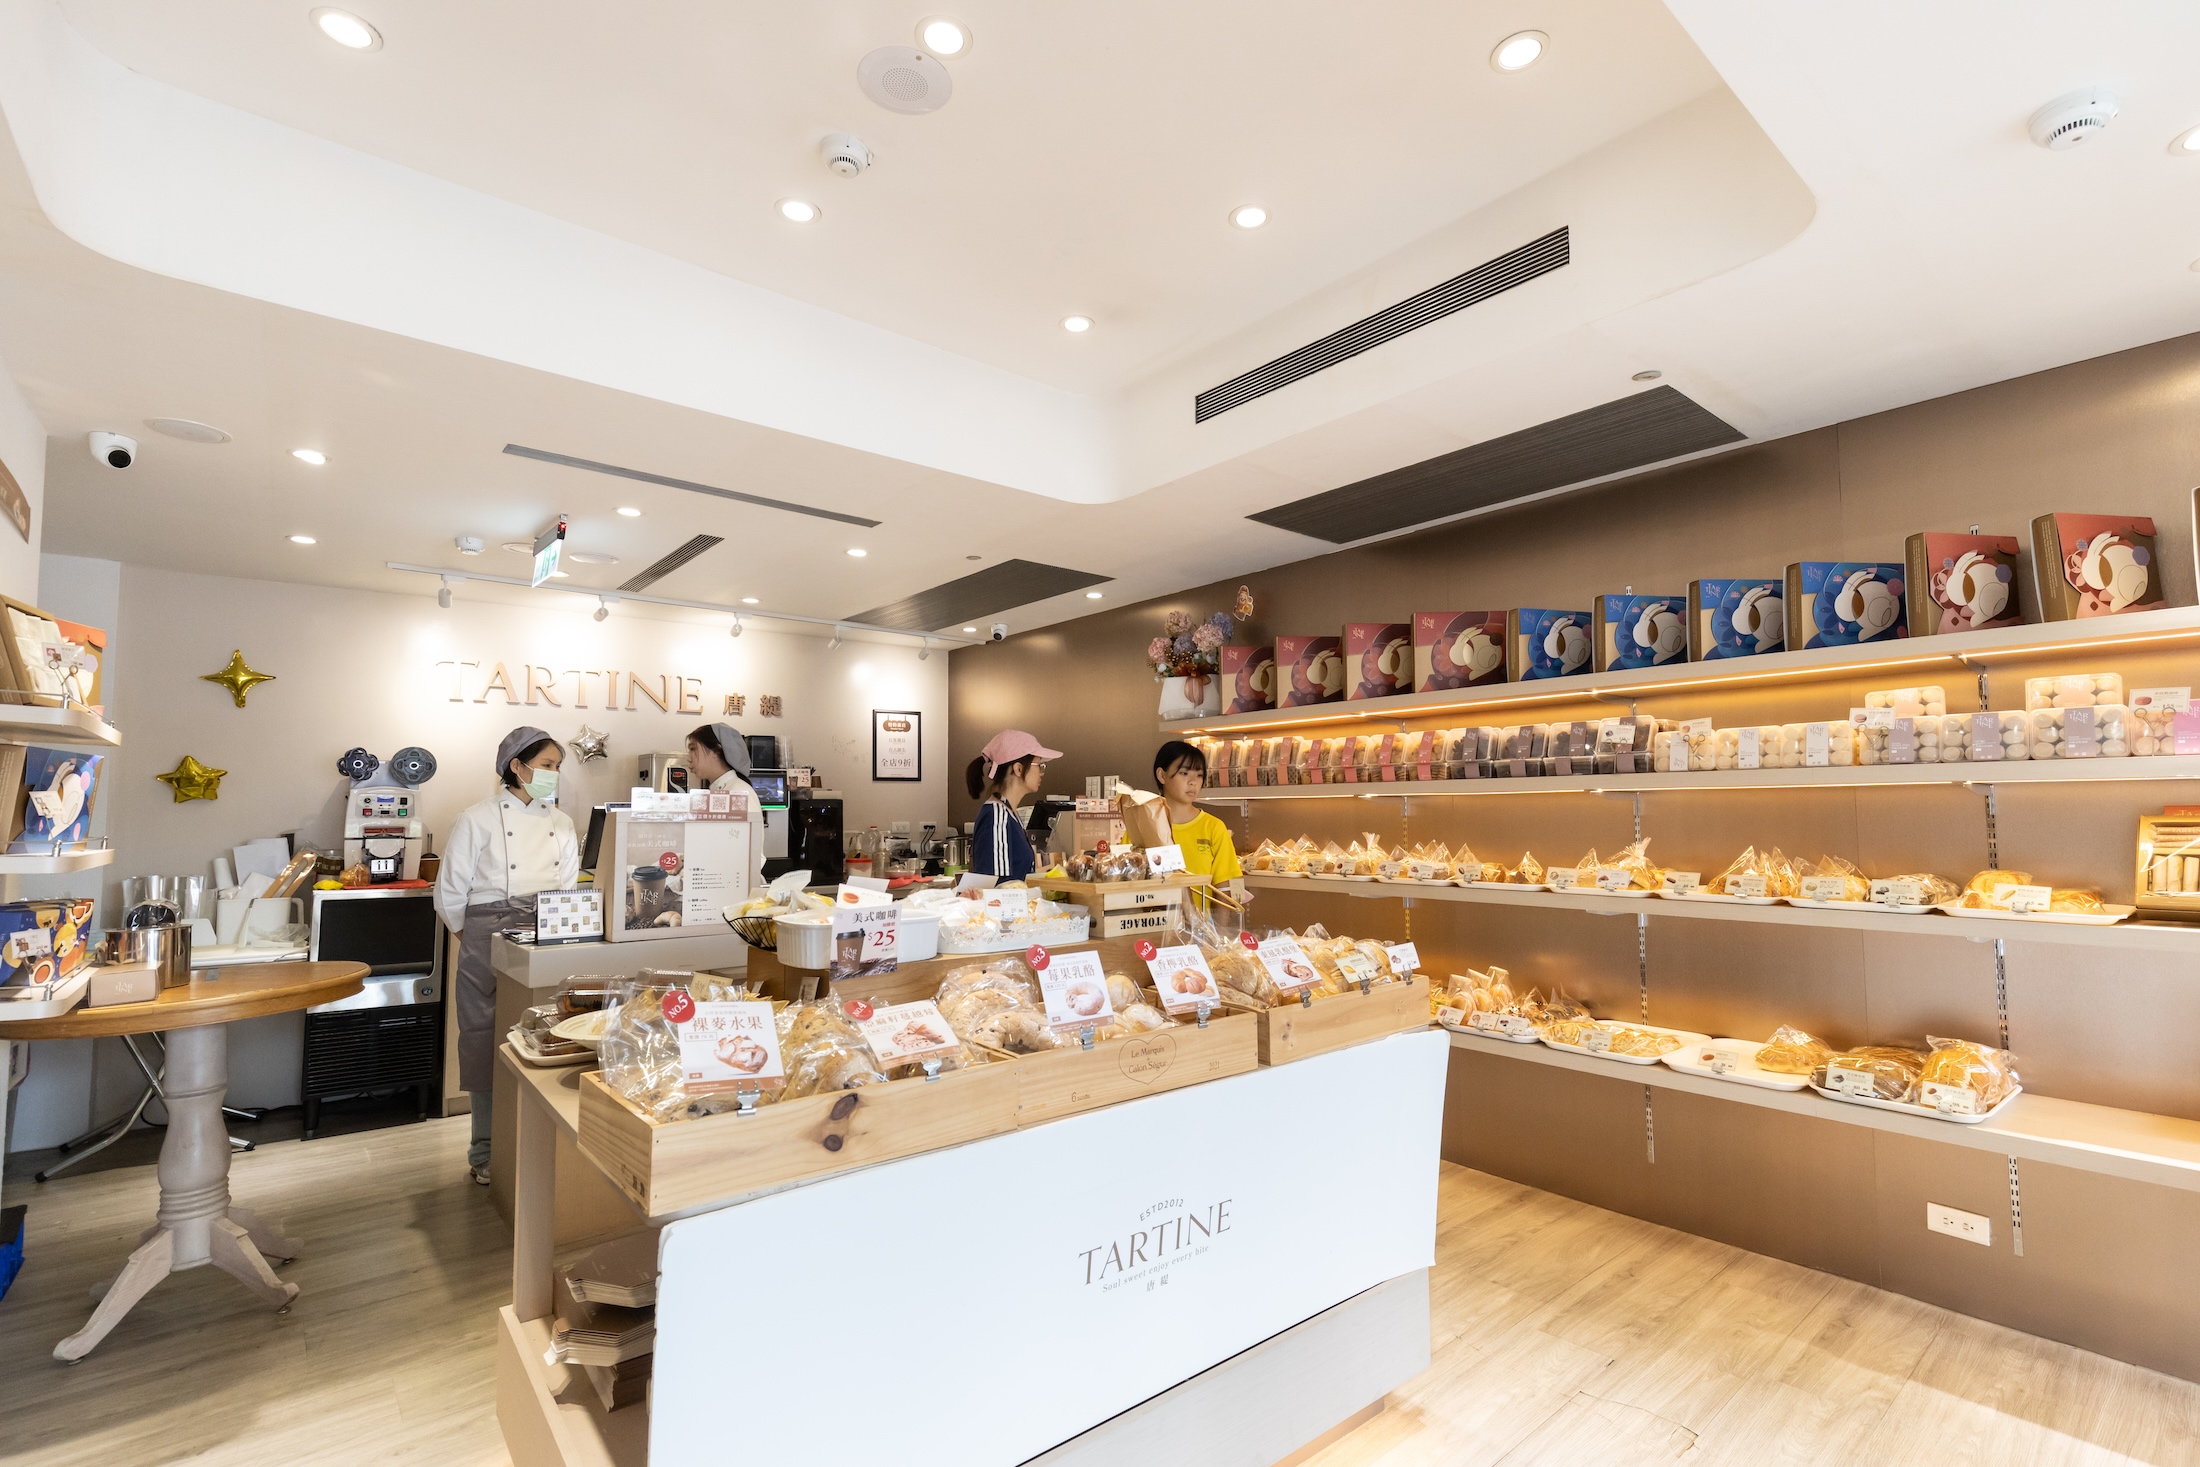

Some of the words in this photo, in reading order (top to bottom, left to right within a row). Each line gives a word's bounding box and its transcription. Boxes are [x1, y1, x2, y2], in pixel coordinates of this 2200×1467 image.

[435, 660, 704, 715] TARTINE
[642, 888, 658, 899] TAR
[853, 909, 898, 924] 美式咖啡
[1120, 916, 1168, 930] STORAGE
[868, 929, 895, 947] $25
[845, 946, 858, 955] TAR
[1031, 948, 1046, 966] NO.3
[1140, 942, 1153, 958] NO.2
[1048, 964, 1095, 982] 莓果乳酪
[668, 994, 688, 1018] NO.5
[852, 1001, 868, 1018] NO.4
[692, 1016, 763, 1032] 裸麥水果
[1131, 1049, 1140, 1058] Le
[1140, 1045, 1165, 1058] Marquis
[1128, 1064, 1147, 1074] Calon
[1072, 1092, 1076, 1102] 6
[1139, 1198, 1184, 1222] ESTD2012
[1078, 1198, 1232, 1286] TARTINE
[1102, 1278, 1122, 1293] Soul
[1124, 1270, 1146, 1285] sweet
[1148, 1262, 1170, 1275] enjoy
[1171, 1252, 1192, 1266] every
[1195, 1245, 1209, 1256] bite
